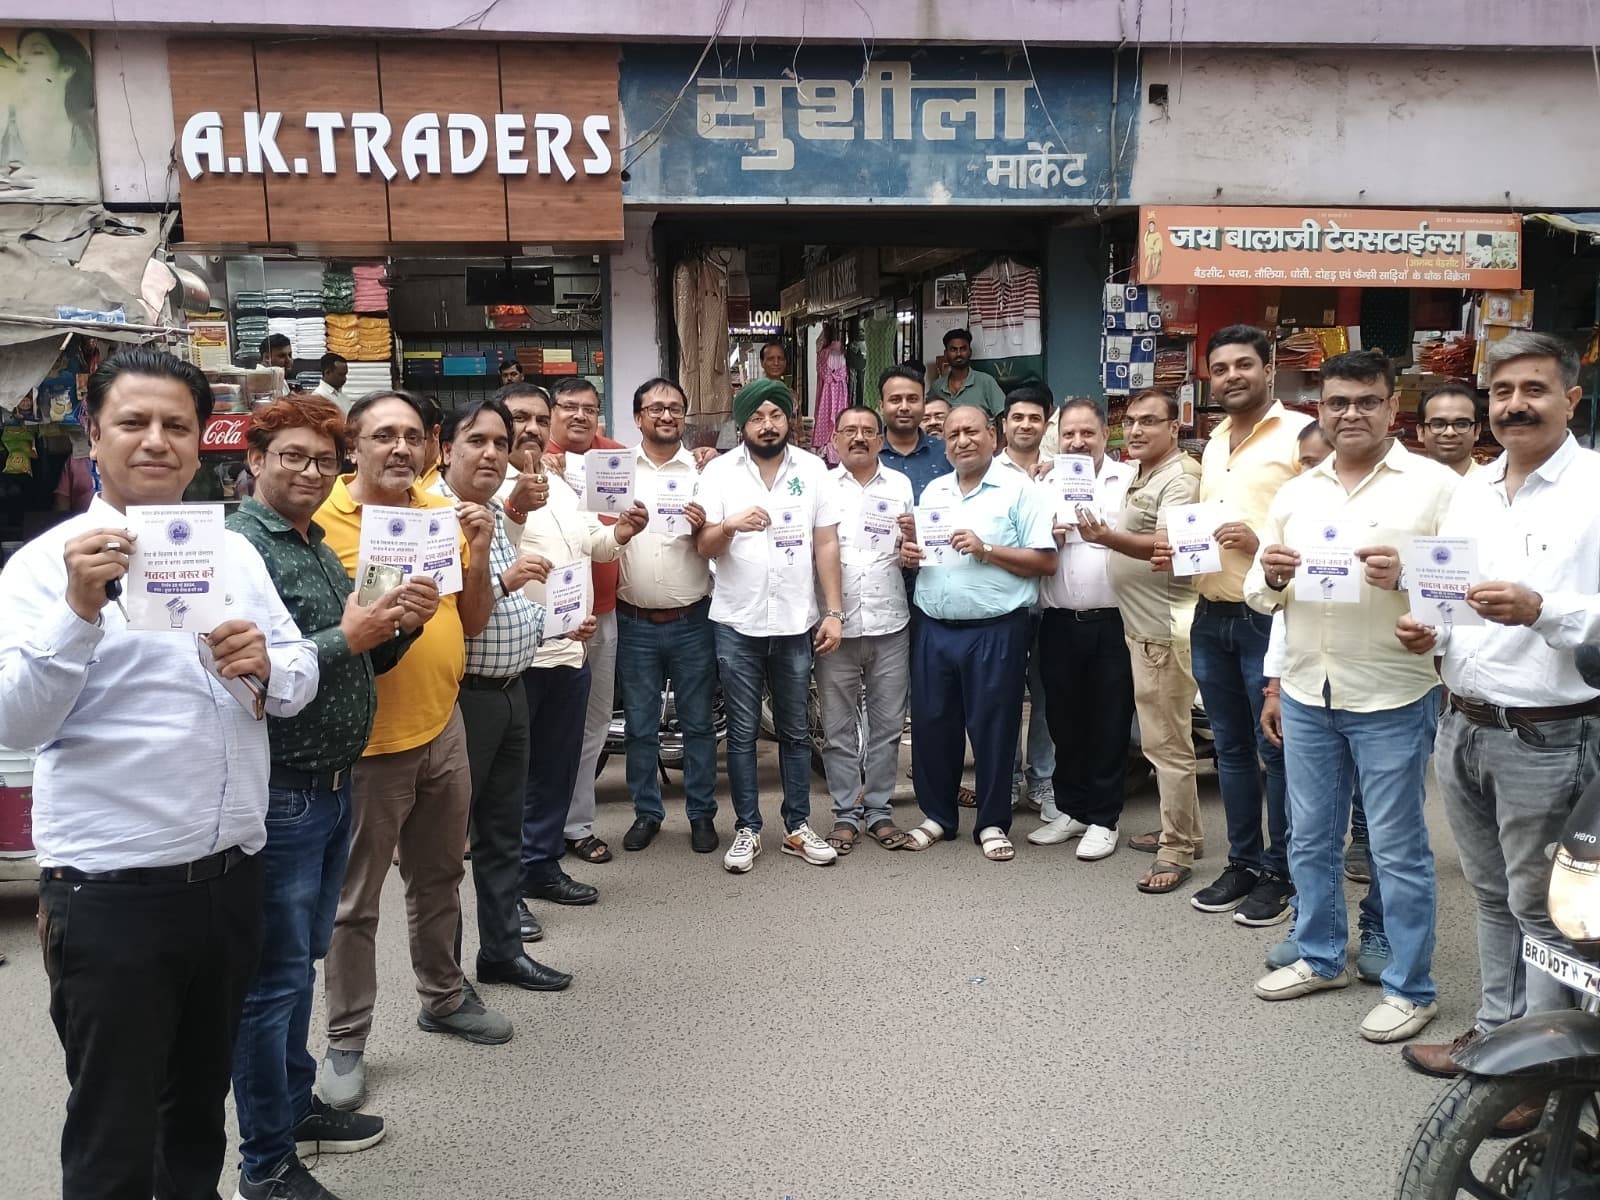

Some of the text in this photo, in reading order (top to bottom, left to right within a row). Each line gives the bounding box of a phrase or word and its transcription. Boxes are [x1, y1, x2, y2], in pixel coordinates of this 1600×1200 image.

[696, 61, 1033, 171] सुशीला
[985, 142, 1087, 190] मार्केट
[1168, 226, 1220, 251] जय
[1224, 218, 1322, 252] बालाजी
[749, 310, 781, 327] LOOM
